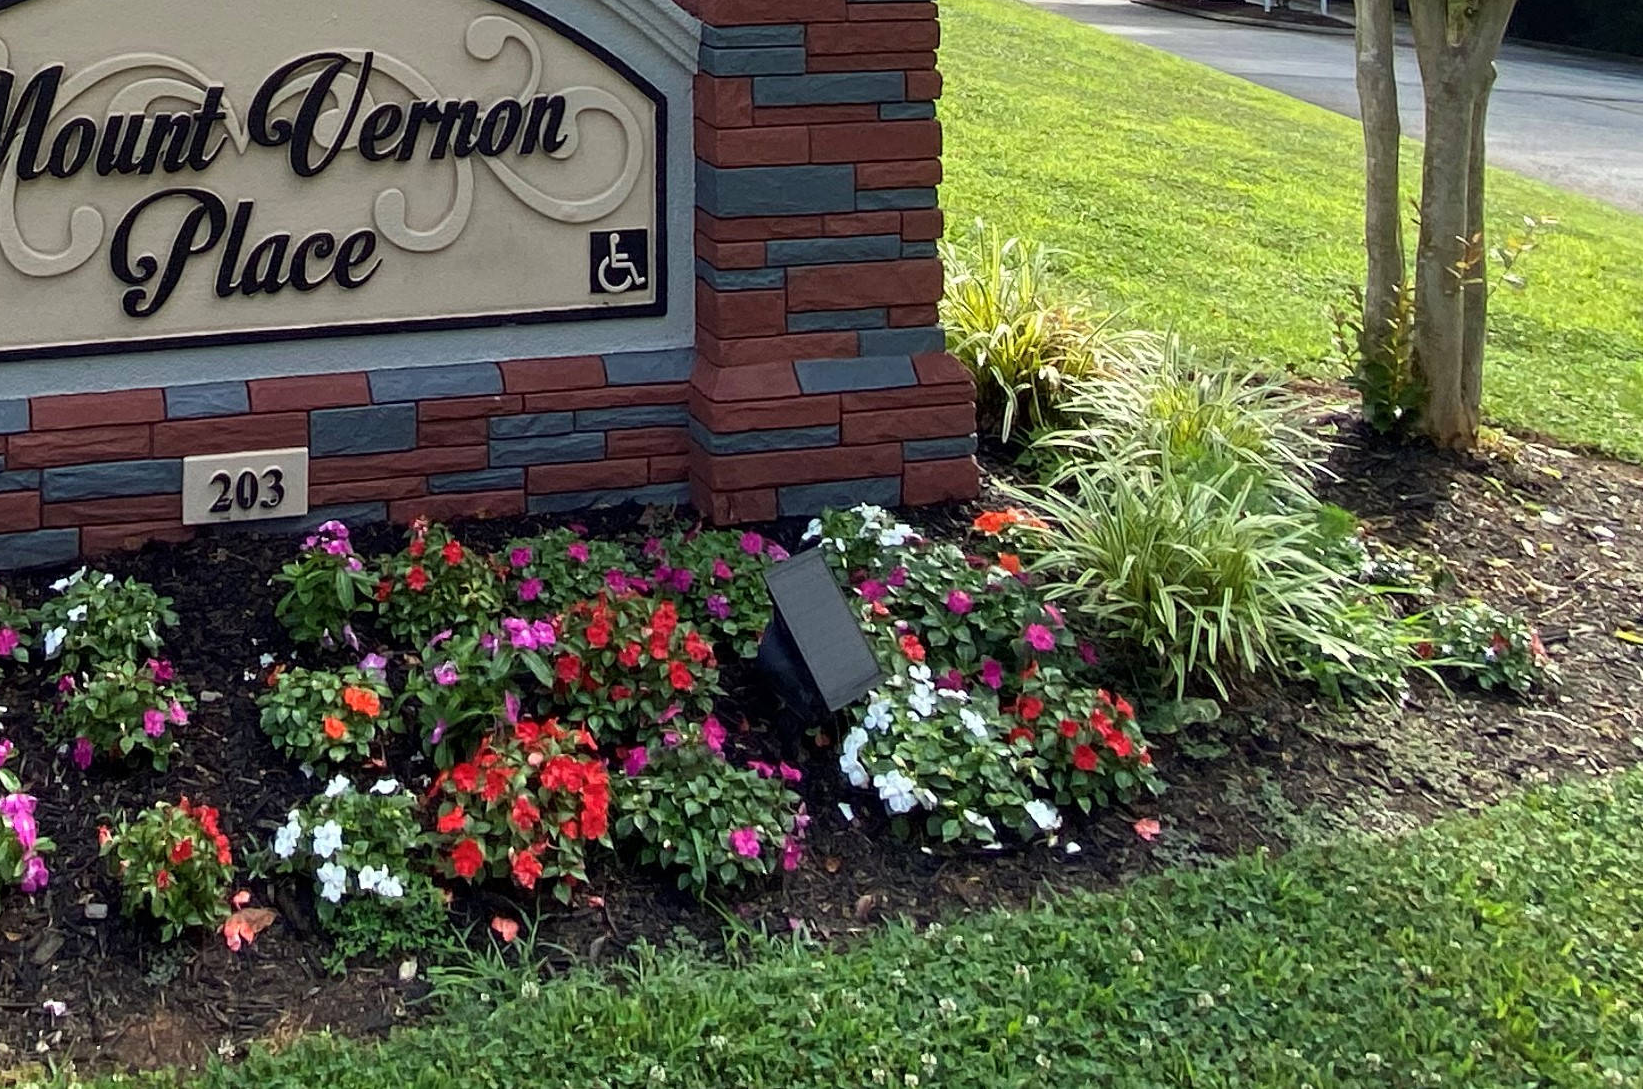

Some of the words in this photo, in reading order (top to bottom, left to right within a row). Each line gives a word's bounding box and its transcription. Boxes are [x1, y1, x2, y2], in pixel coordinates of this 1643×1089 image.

[248, 49, 569, 178] Vernon
[109, 187, 384, 320] Place
[208, 466, 286, 514] 203
